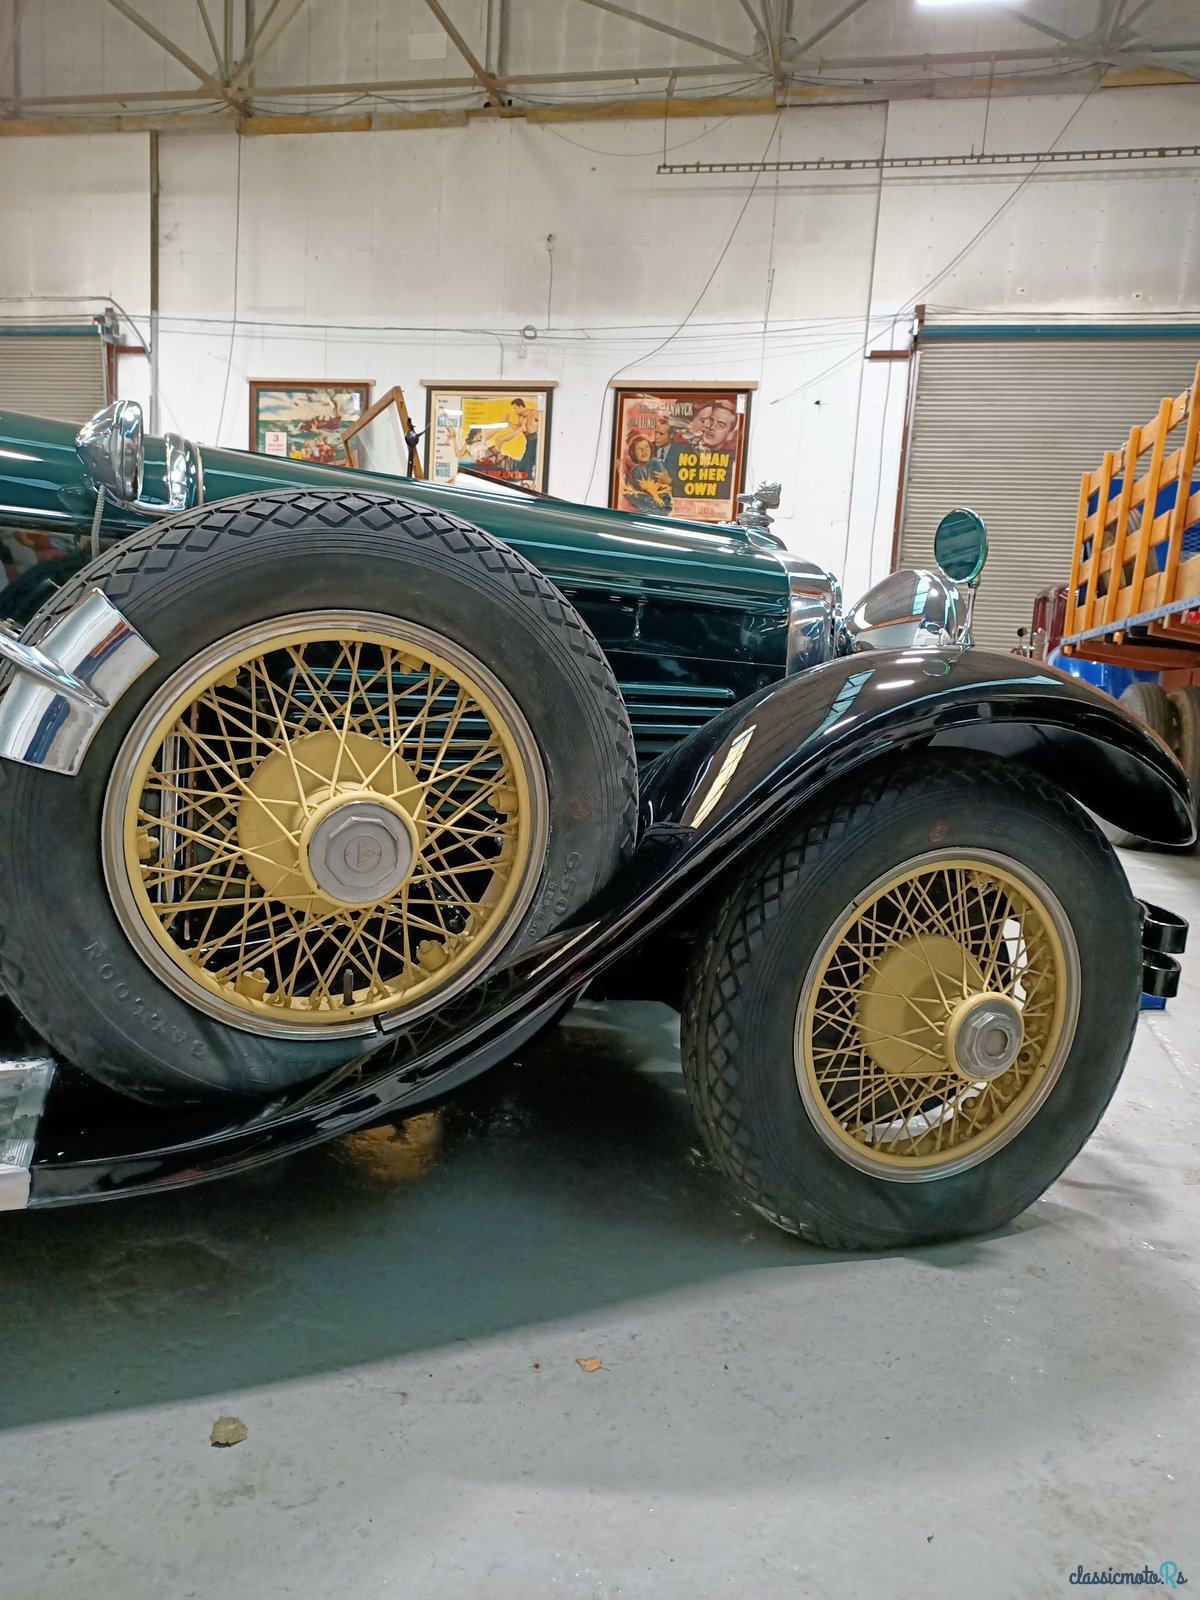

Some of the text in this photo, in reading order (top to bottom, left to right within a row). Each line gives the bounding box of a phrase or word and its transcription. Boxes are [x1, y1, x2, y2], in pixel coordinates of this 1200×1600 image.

[659, 402, 694, 416] ANWYCK
[678, 452, 730, 467] NO MAN
[678, 467, 727, 482] OF HER
[684, 482, 718, 496] OWN
